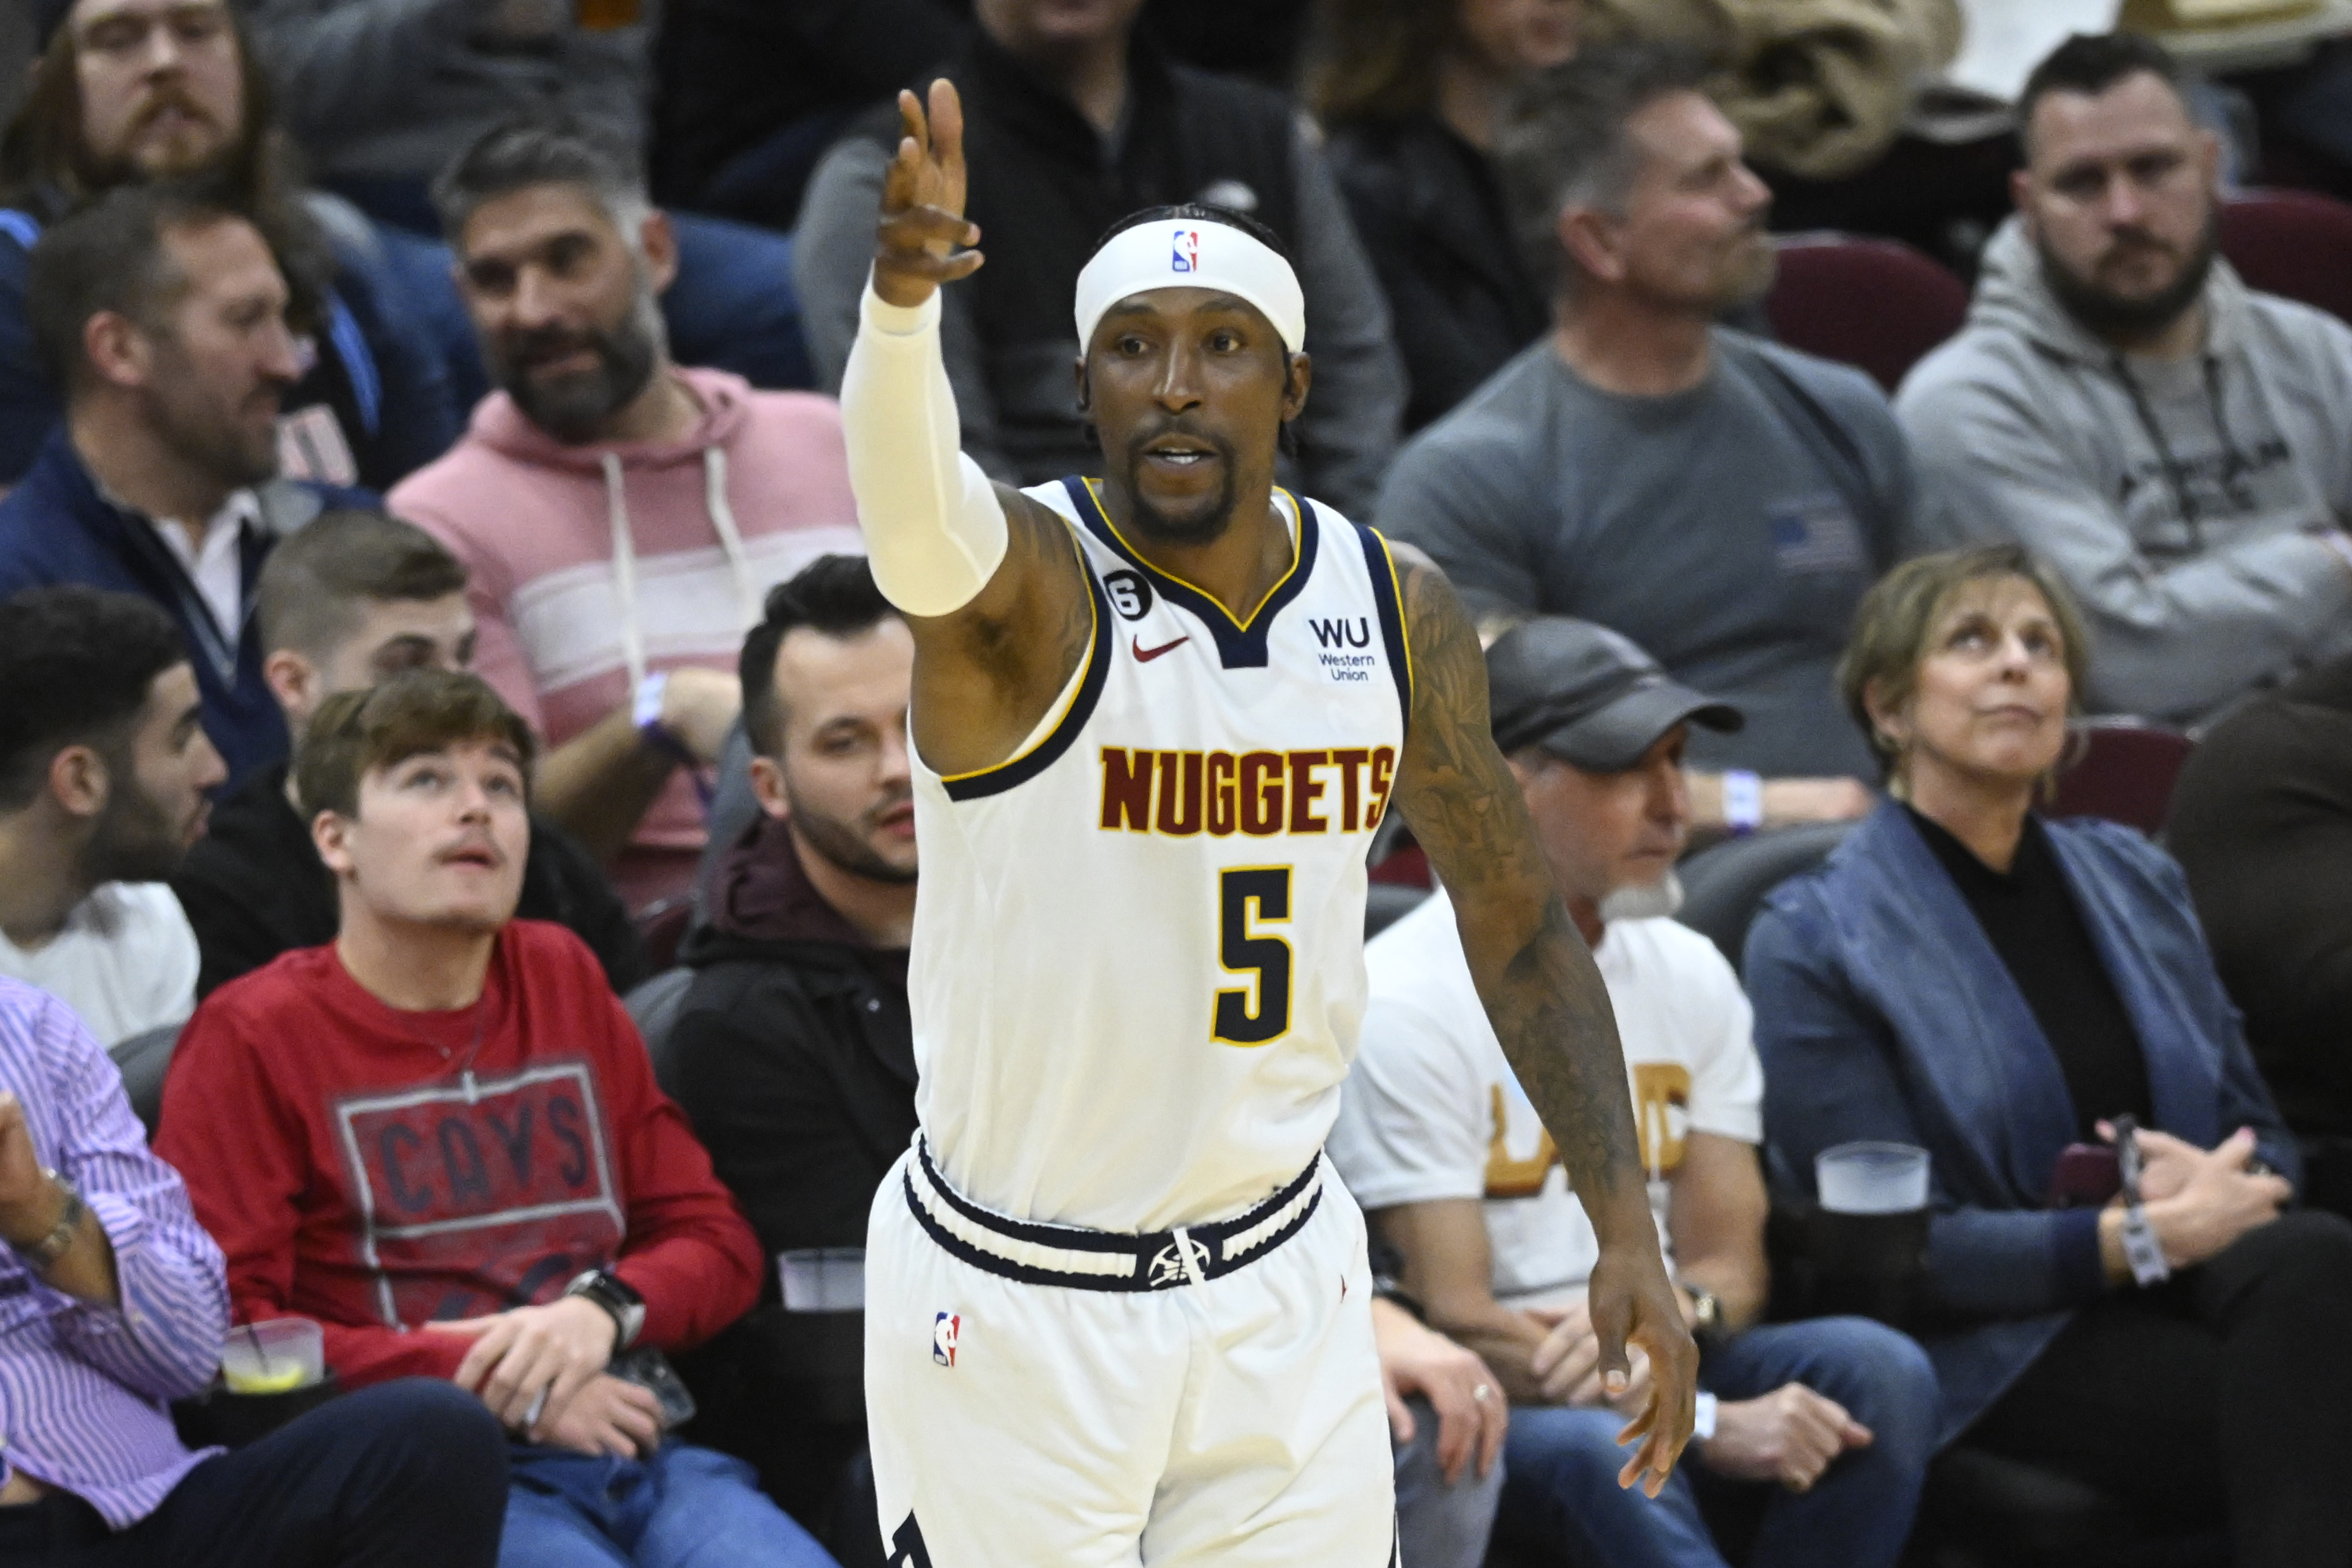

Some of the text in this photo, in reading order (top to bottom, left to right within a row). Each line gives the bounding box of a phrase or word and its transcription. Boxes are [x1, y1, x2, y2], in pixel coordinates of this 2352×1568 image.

[1108, 577, 1141, 616] 6
[1308, 617, 1371, 648] WU
[1318, 653, 1375, 667] Western
[1331, 667, 1369, 681] Union
[1098, 744, 1395, 839] NUGGETS
[1209, 863, 1295, 1048] 5
[380, 1095, 589, 1213] CAVS
